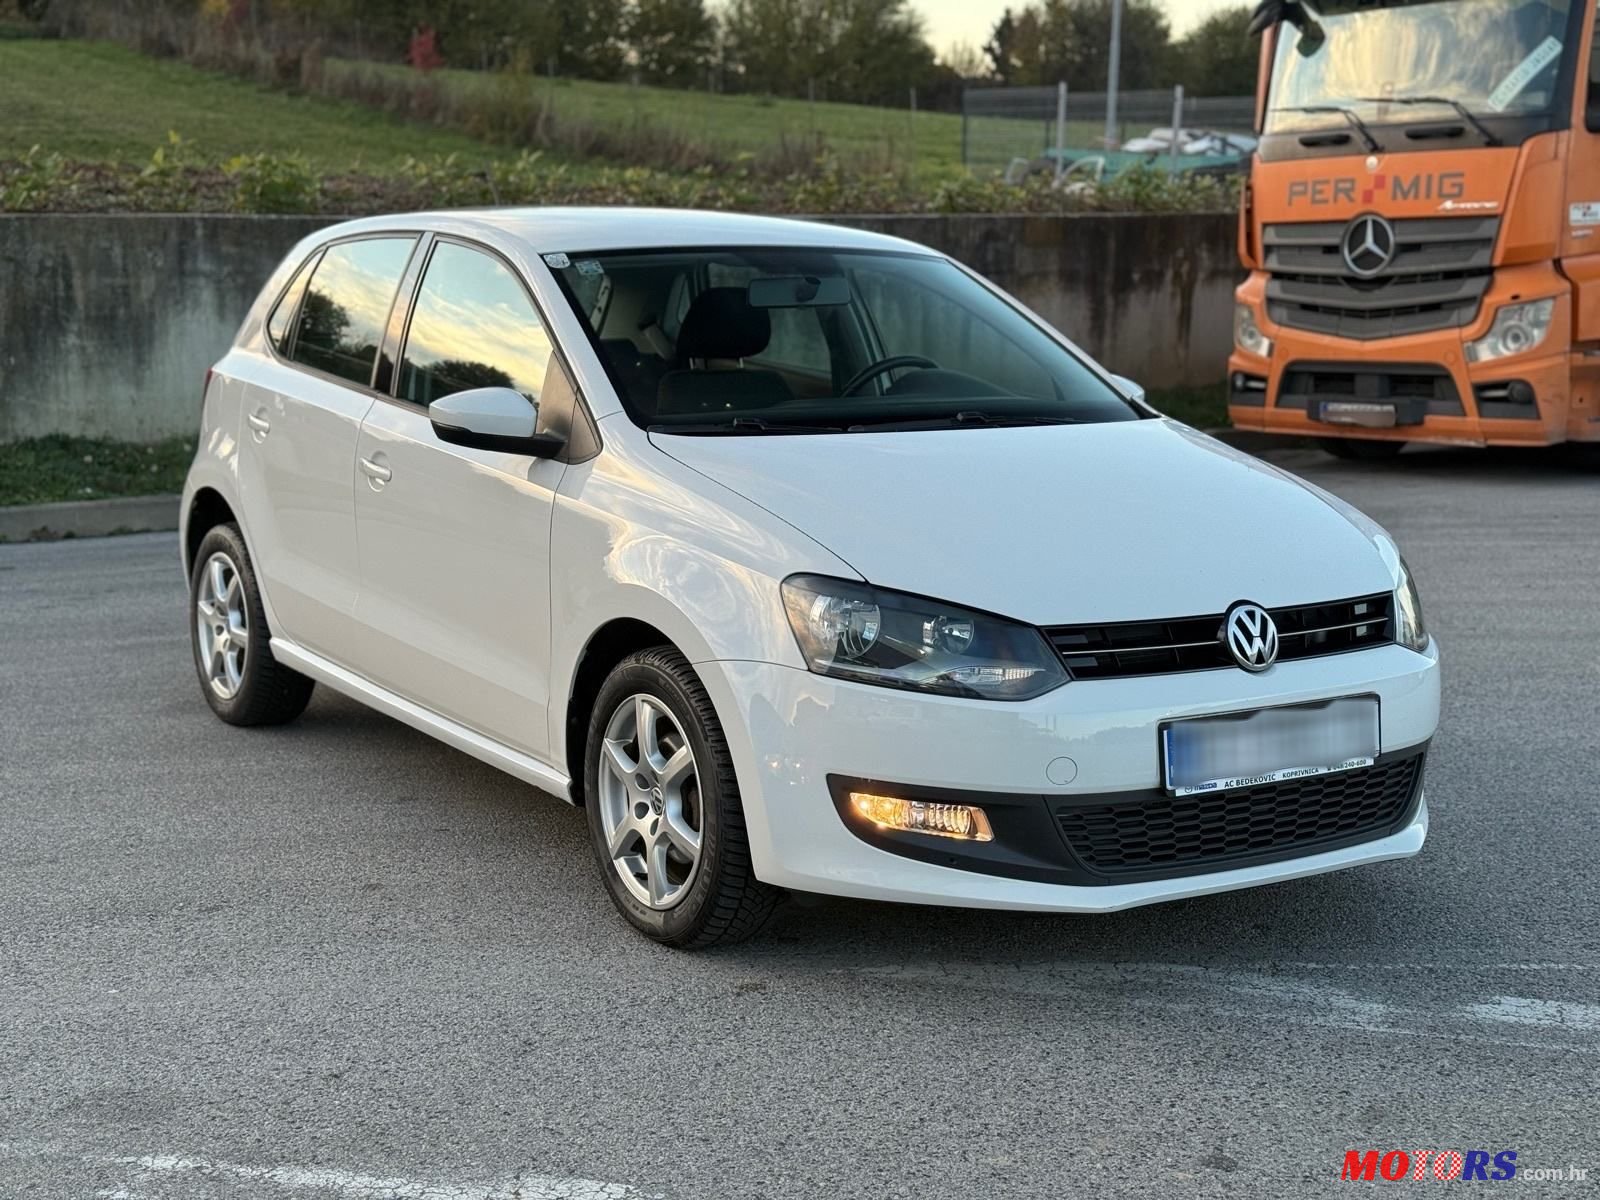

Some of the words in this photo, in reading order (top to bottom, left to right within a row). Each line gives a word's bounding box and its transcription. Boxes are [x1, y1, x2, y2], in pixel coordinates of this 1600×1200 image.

[1287, 178, 1356, 207] PER
[1391, 172, 1464, 200] MIG
[1282, 767, 1319, 780] KOPRIVNICA
